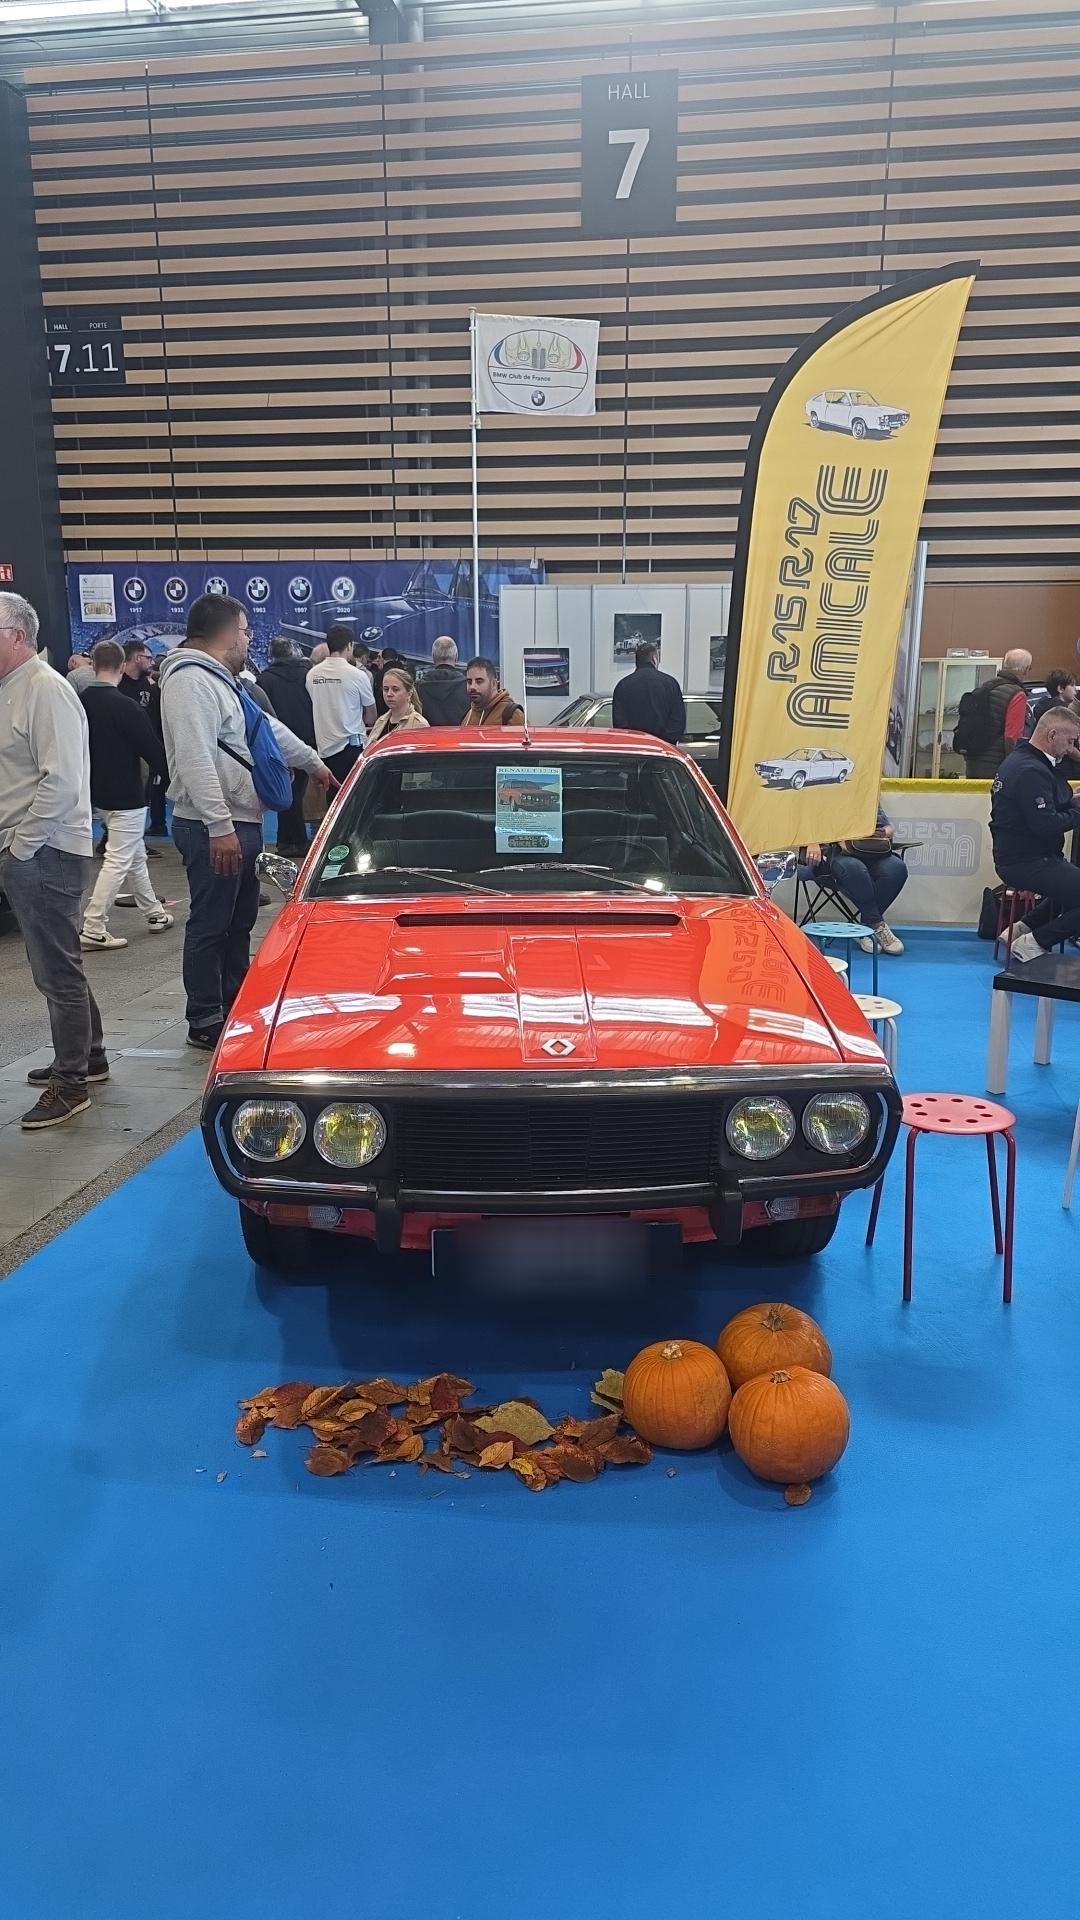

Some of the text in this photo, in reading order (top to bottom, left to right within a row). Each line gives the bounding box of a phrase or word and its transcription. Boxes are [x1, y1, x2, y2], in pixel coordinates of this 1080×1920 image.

[608, 82, 650, 100] HALL
[608, 128, 650, 199] 7
[54, 343, 119, 373] 7.11
[493, 371, 507, 379] BMW
[531, 374, 551, 382] France
[786, 464, 889, 729] AMICALE
